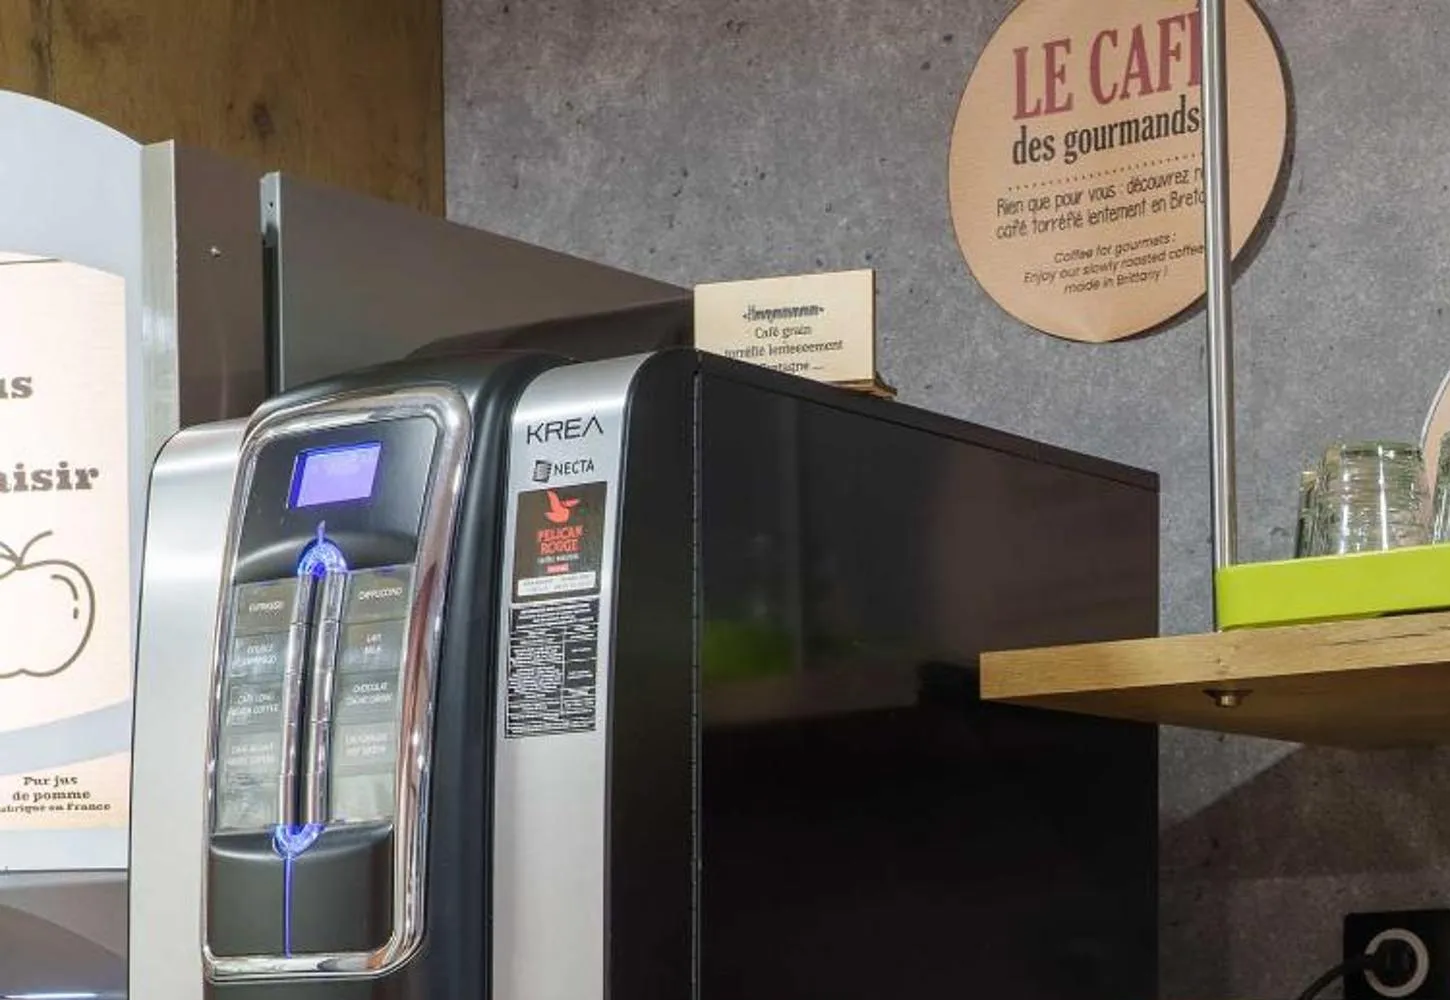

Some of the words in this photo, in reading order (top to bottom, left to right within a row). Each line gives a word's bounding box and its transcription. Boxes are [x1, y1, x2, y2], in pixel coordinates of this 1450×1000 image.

[1012, 39, 1074, 121] LE
[1013, 124, 1055, 165] des
[1063, 94, 1201, 165] gourmands
[996, 197, 1024, 217] Rien
[1028, 195, 1050, 215] que
[1055, 191, 1083, 213] pour
[1088, 184, 1117, 201] vous
[1126, 171, 1190, 196] découvrez
[995, 218, 1028, 240] café
[1087, 199, 1147, 227] lentement
[1151, 197, 1167, 209] en
[1053, 246, 1094, 264] Coffee
[1095, 244, 1113, 259] for
[1023, 268, 1056, 286] Enjoy
[1058, 266, 1081, 280] our
[1082, 260, 1119, 278] slowly
[1120, 250, 1167, 269] roasted
[1063, 278, 1100, 295] made
[1102, 276, 1115, 288] in
[1116, 268, 1162, 287] Brittany
[754, 326, 780, 340] Café
[553, 456, 596, 477] NECTA
[22, 775, 51, 787] Pur
[53, 774, 79, 788] jus
[12, 791, 31, 802] de
[32, 790, 92, 803] pomme
[66, 802, 112, 812] France
